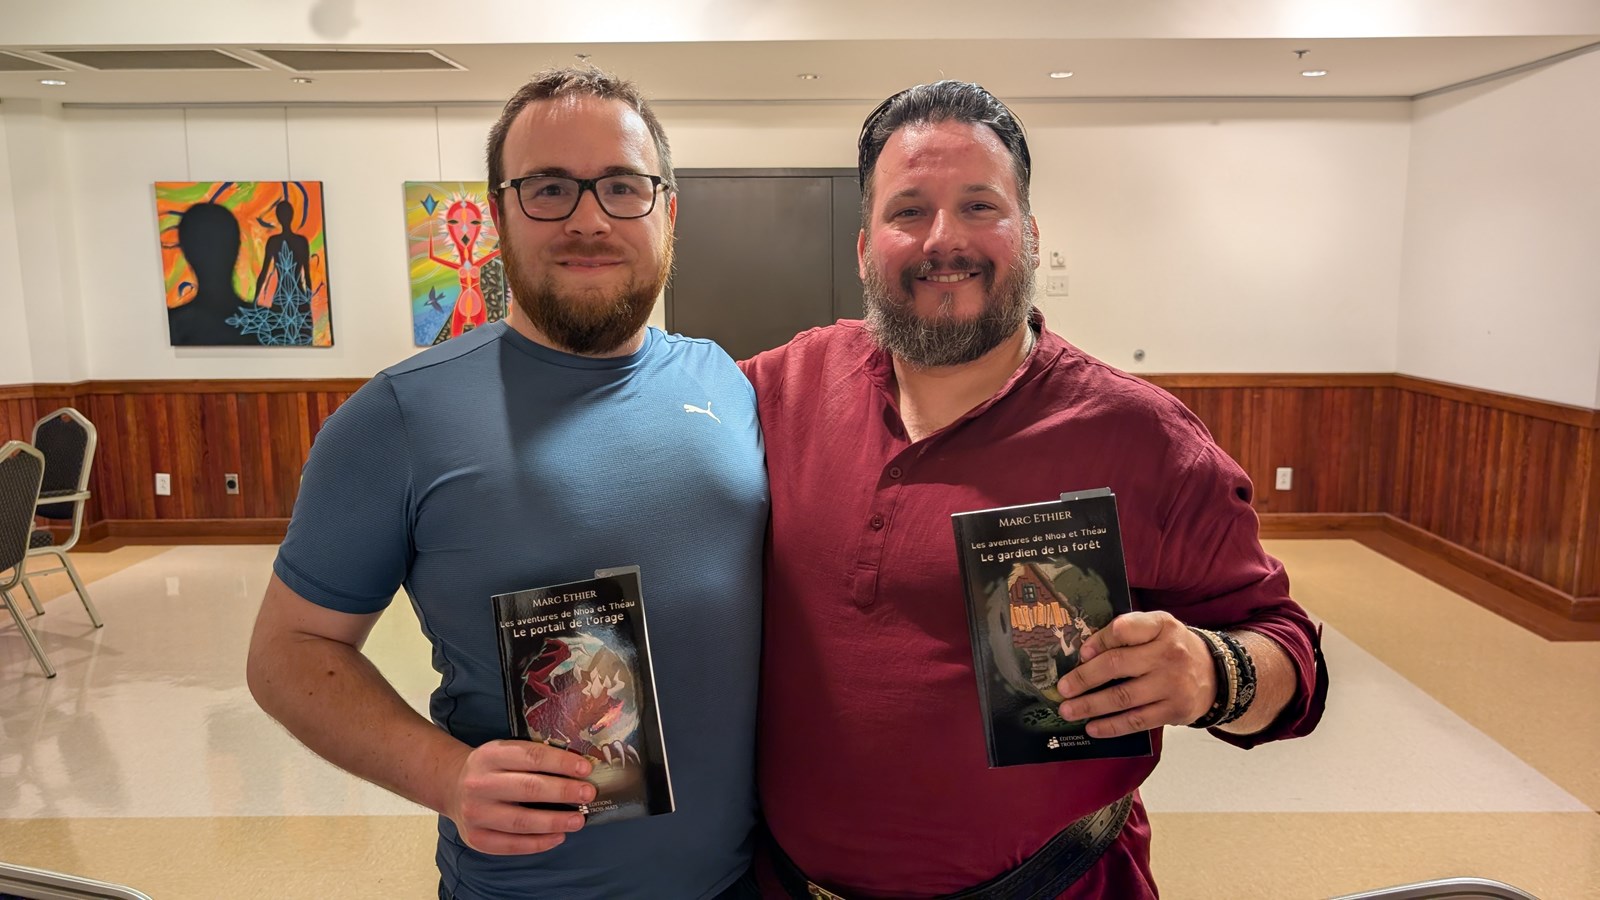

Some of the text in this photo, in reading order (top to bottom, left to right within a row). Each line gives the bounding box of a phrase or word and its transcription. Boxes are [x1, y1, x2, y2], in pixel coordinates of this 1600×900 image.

[999, 510, 1072, 528] MARC ETHIER
[971, 525, 1107, 550] Les aventures de Nhoa et Théau
[980, 539, 1101, 563] Le gardien de la forêt
[532, 590, 598, 608] MARC ETHIER
[500, 599, 636, 628] Les aventures de Nhoa et Théau
[513, 628, 527, 638] Le
[530, 622, 566, 637] portail
[569, 619, 583, 629] de
